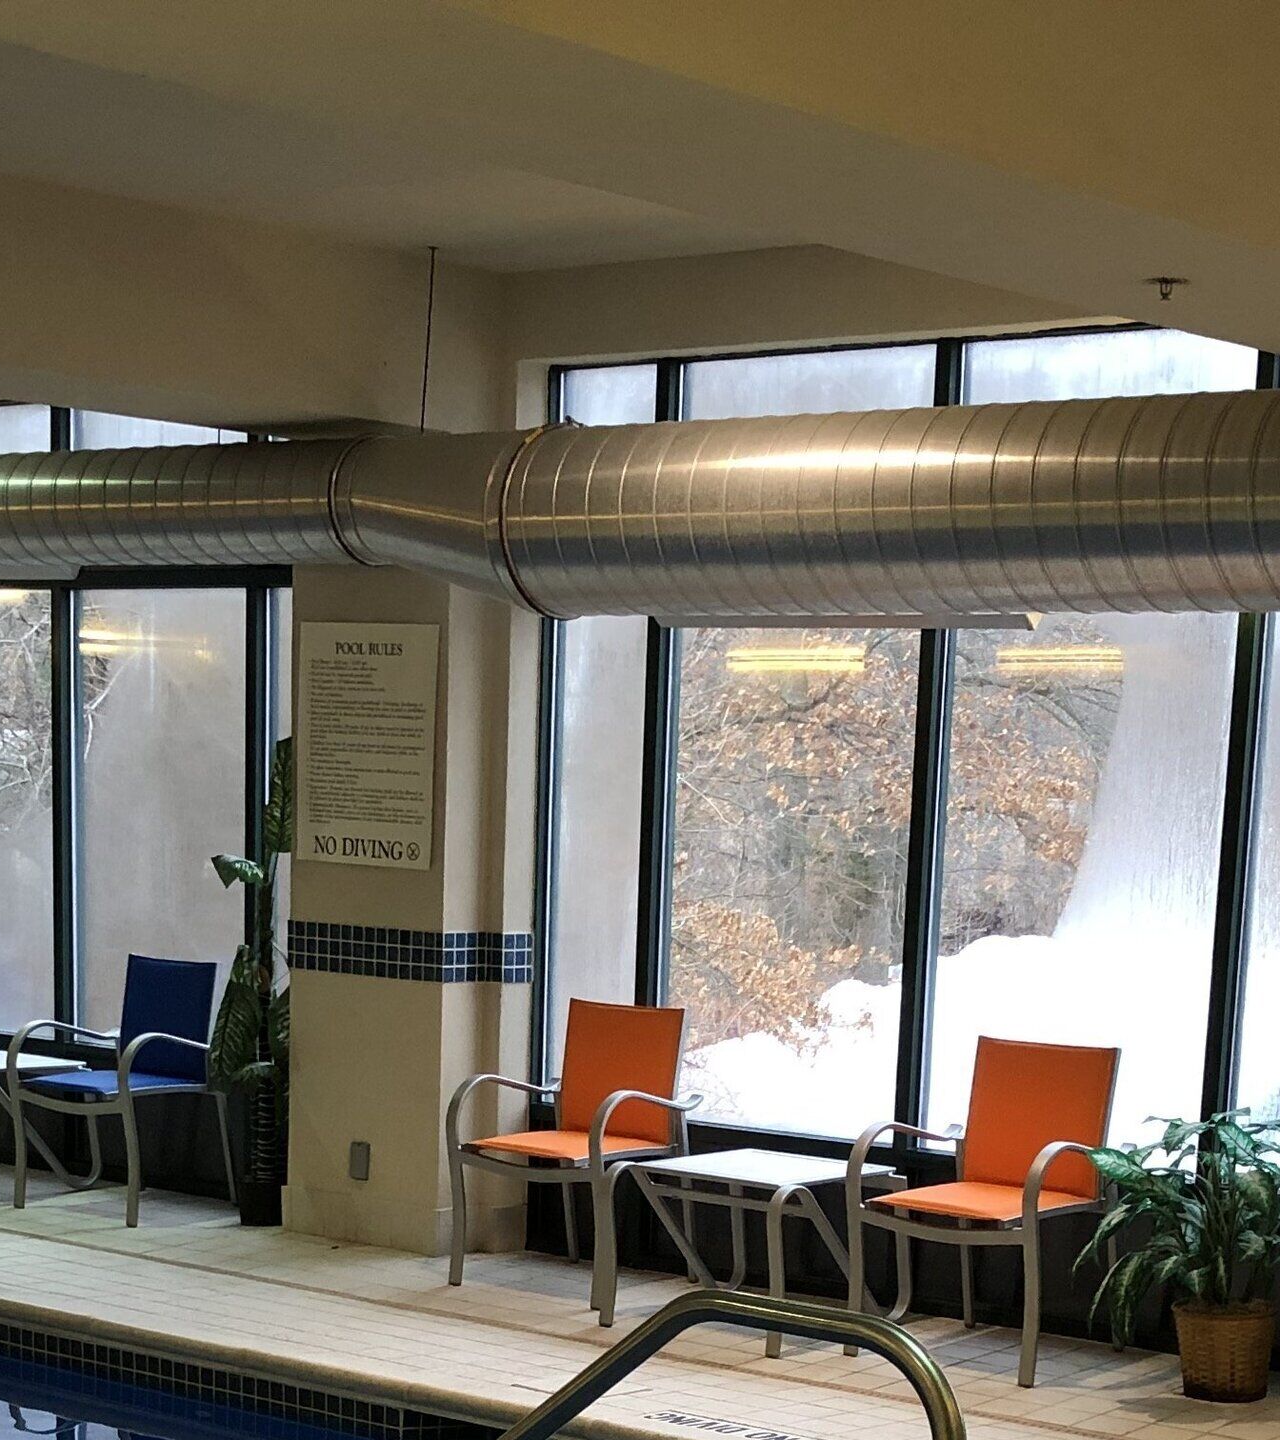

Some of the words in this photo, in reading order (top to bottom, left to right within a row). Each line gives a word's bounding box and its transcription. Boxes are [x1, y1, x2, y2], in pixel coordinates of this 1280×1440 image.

[335, 641, 367, 655] POOL
[369, 642, 403, 656] RULES
[314, 835, 338, 855] NO
[342, 837, 404, 861] DIVING
[644, 1412, 748, 1434] DIVING
